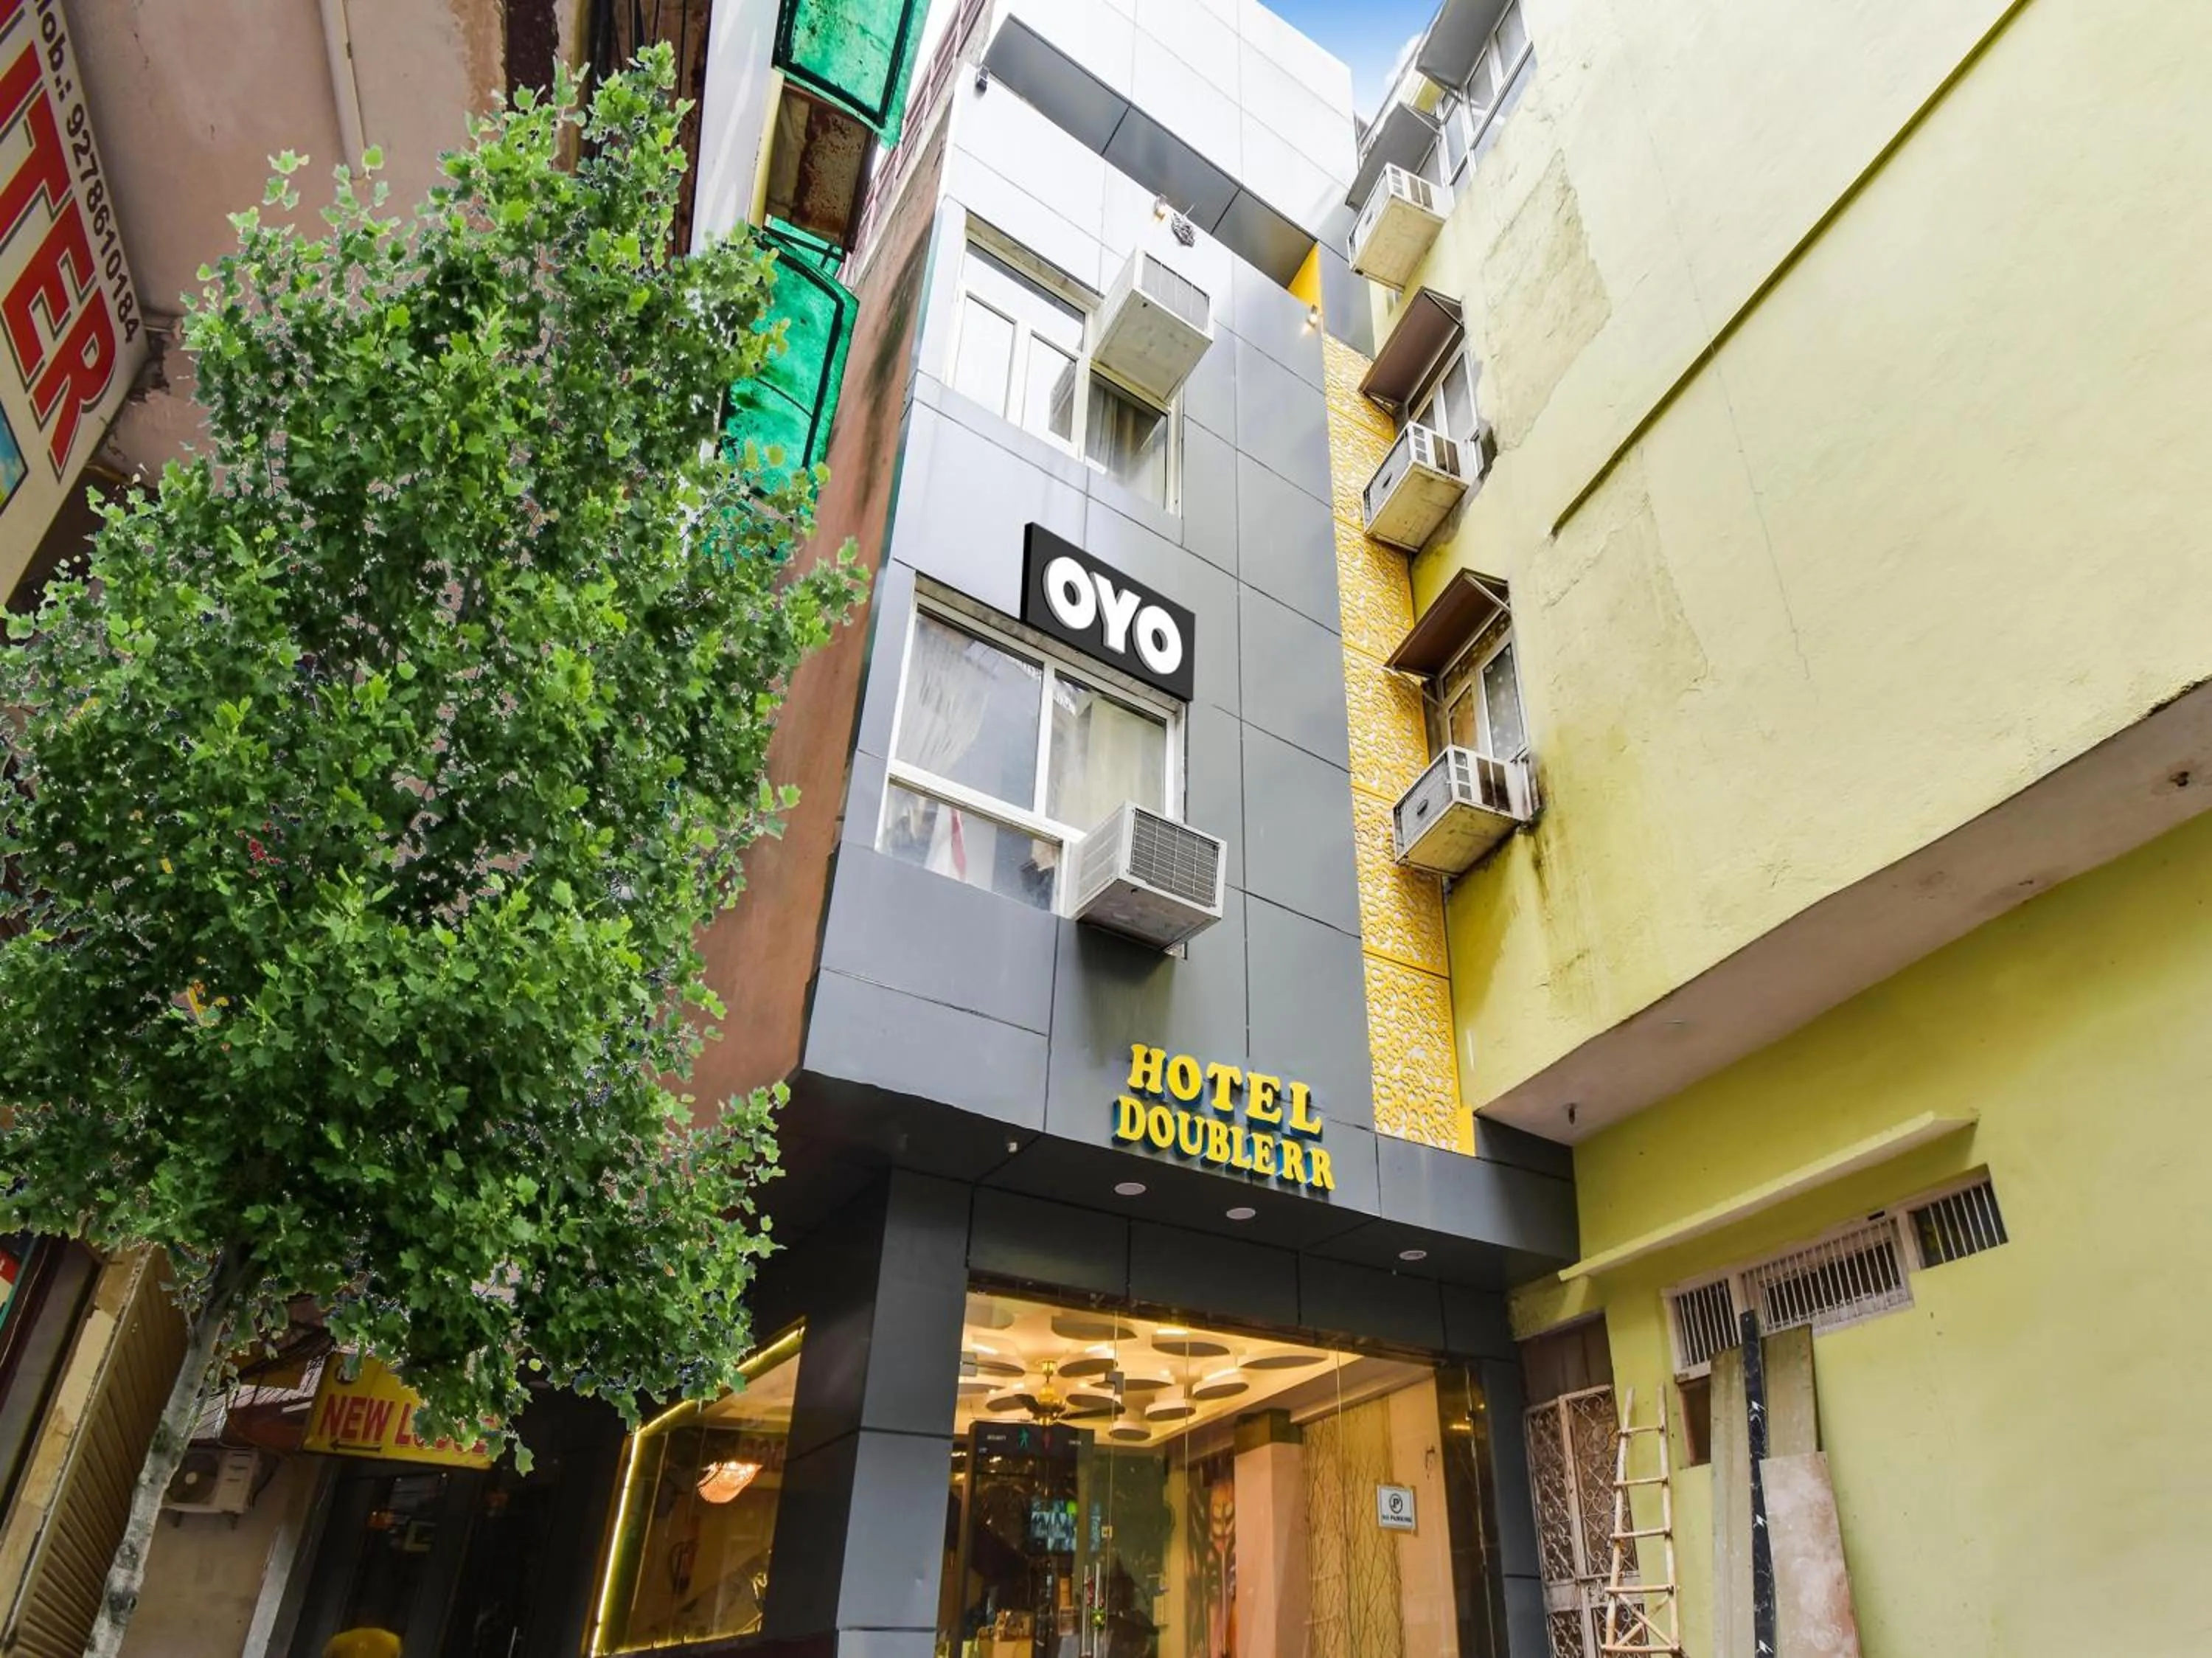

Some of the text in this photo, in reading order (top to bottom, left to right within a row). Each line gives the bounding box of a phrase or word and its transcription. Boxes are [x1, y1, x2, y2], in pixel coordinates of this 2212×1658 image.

[66, 103, 139, 344] 9278610184
[1043, 556, 1183, 674] OYO
[1127, 1044, 1323, 1139] HOTEL
[319, 1393, 394, 1442] NEW
